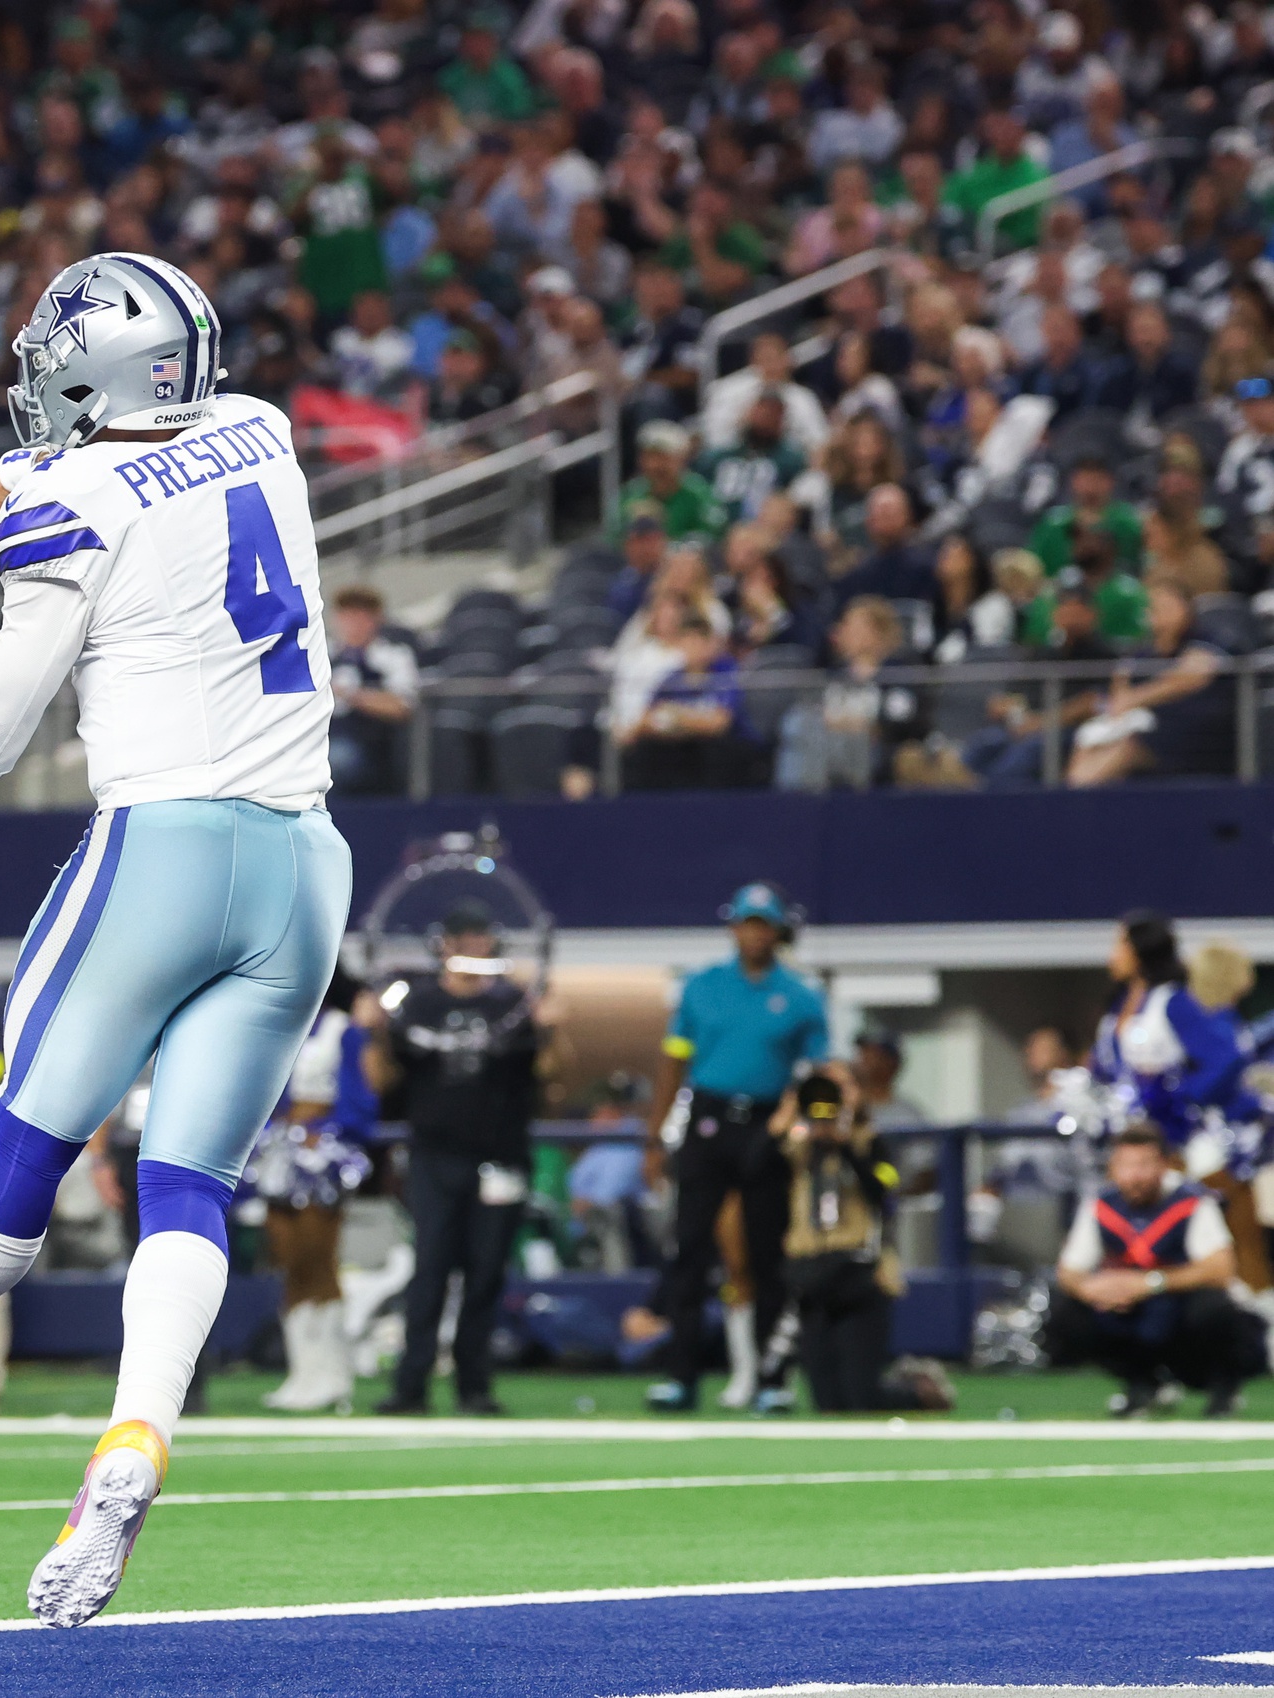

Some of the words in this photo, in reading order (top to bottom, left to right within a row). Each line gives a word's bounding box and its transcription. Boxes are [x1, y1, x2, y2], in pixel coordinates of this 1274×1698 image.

[154, 410, 203, 424] CHOOSE
[156, 385, 172, 398] 94
[113, 416, 290, 509] PRESCOTT
[224, 481, 317, 695] 4
